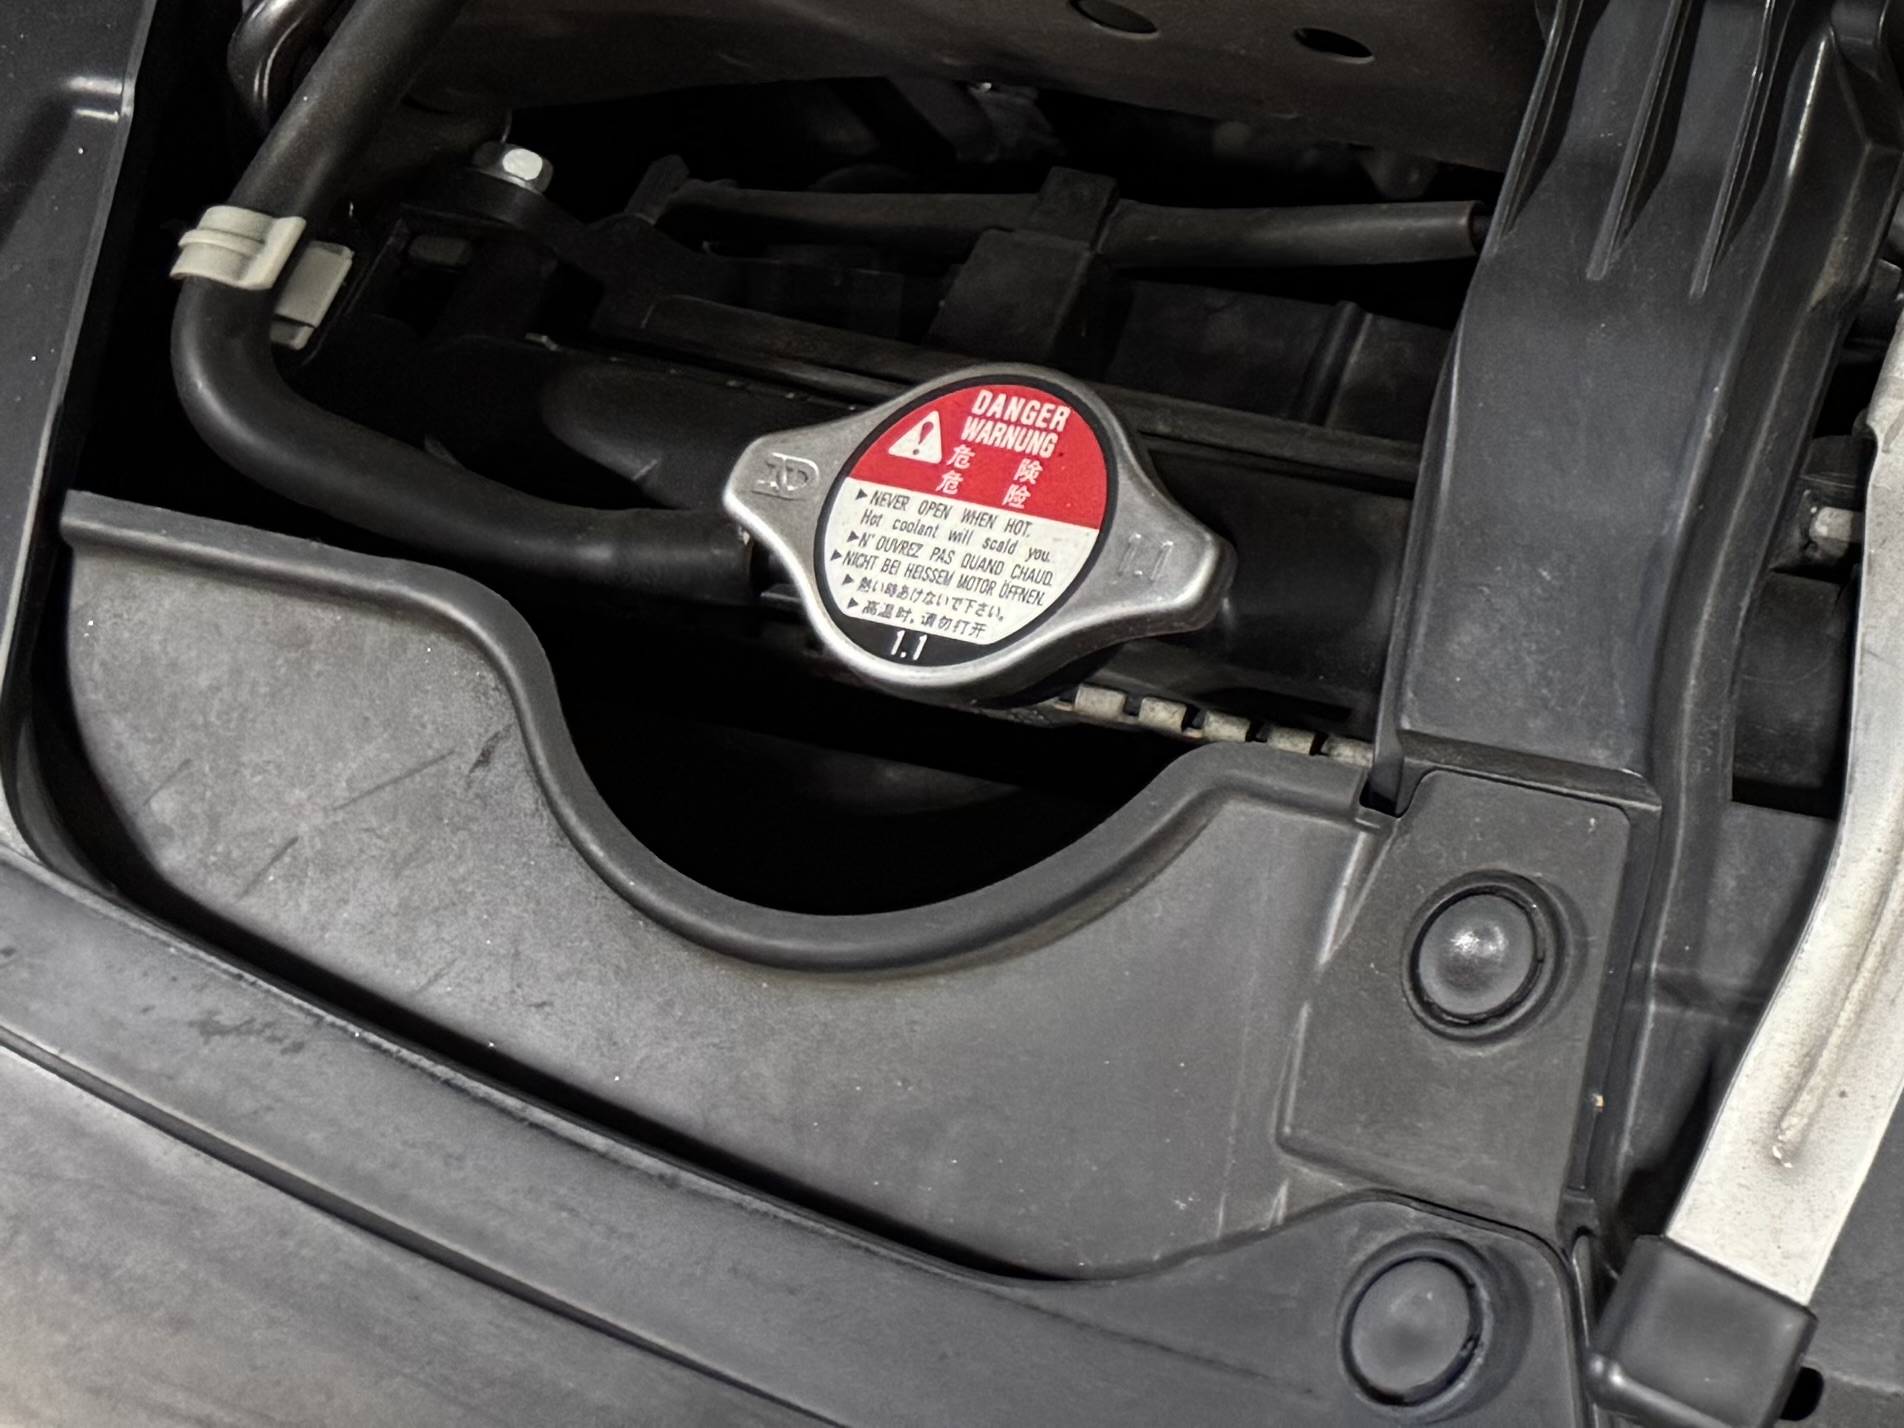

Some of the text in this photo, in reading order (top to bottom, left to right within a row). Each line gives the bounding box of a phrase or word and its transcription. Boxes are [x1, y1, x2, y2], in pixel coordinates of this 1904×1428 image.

[972, 388, 1070, 432] DANGER
[960, 416, 1058, 457] WARNUNG
[860, 508, 1051, 563] Hot coolant will scald you.
[869, 489, 1033, 538] NEVER OPEN WHEN HOT.
[842, 550, 879, 571] NICHT
[881, 559, 900, 575] BEI
[904, 562, 956, 587] HEISSEM
[956, 573, 997, 597] MOTOR
[929, 547, 955, 565] PAS
[1010, 563, 1054, 587] CHAUD.
[889, 629, 928, 661] 1.1
